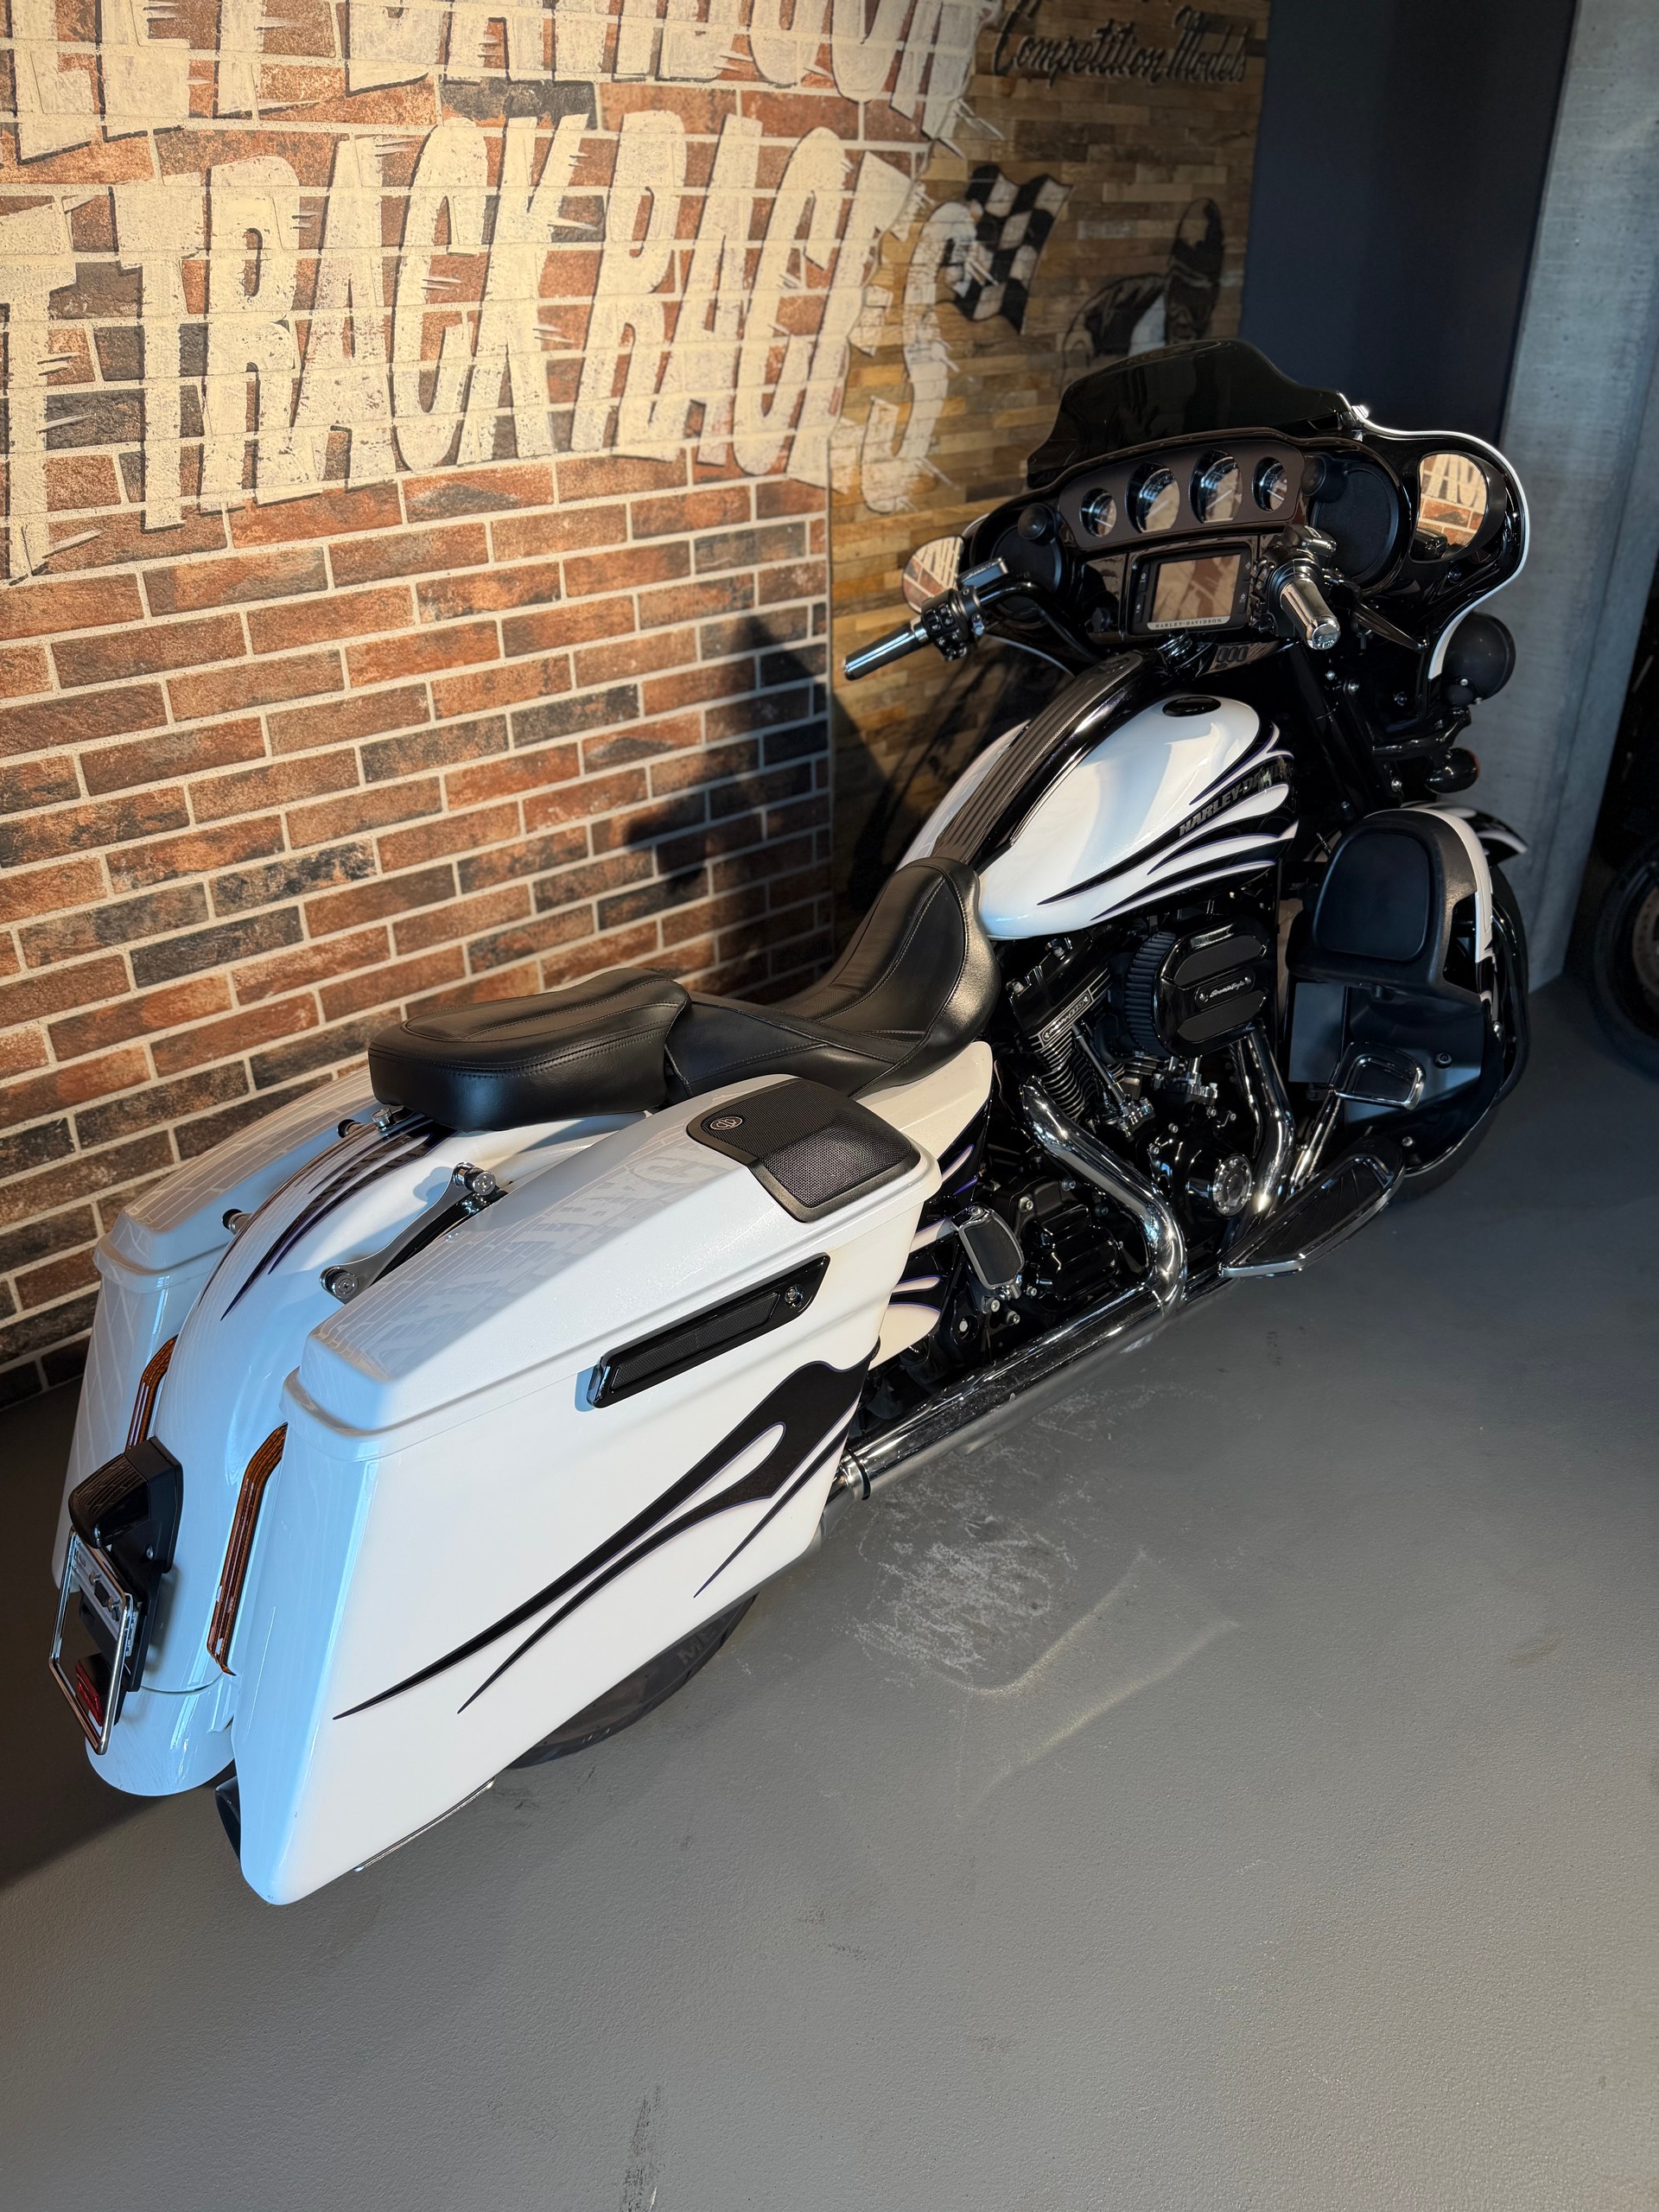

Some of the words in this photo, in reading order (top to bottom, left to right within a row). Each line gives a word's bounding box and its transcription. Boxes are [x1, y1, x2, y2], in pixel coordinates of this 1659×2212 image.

[108, 112, 590, 533] TRACK
[570, 109, 982, 516] RACES
[1154, 617, 1223, 629] HARLEY-DAVIDSON
